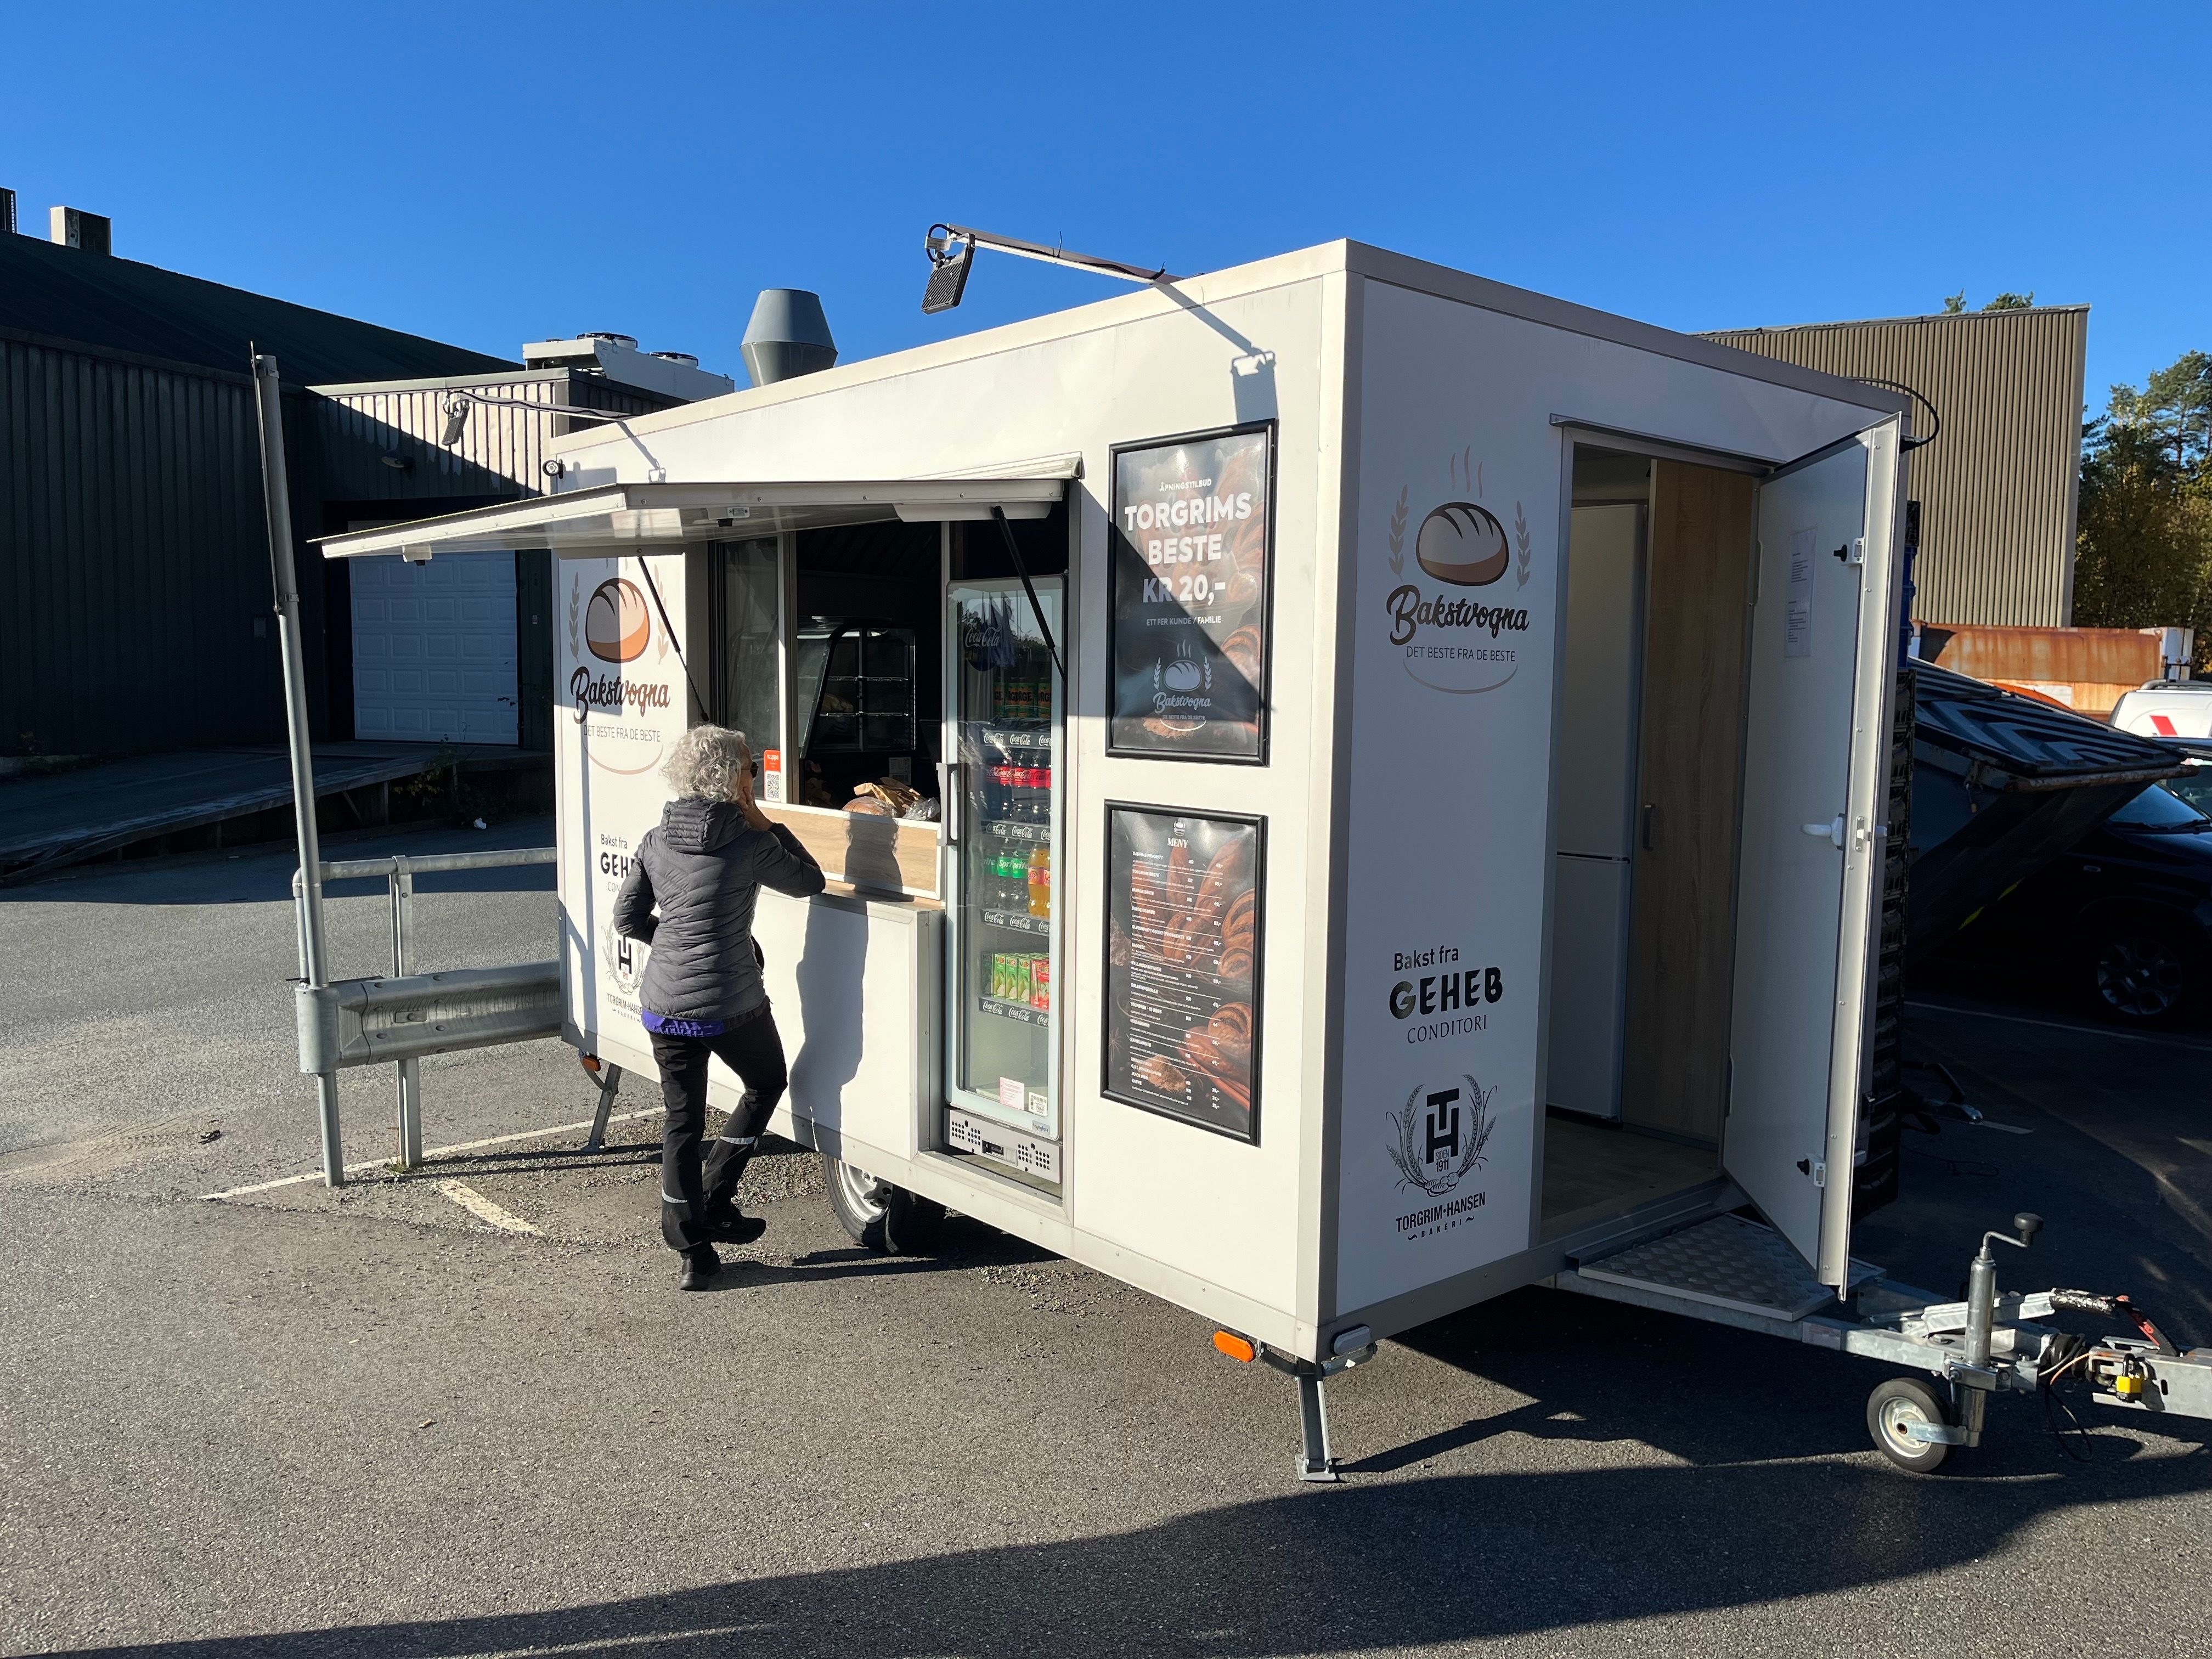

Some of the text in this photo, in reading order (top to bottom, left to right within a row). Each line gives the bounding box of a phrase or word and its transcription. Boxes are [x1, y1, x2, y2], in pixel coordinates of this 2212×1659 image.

[1160, 478, 1212, 492] ÅPNINGSTILBUD
[1124, 492, 1251, 531] TORGRIMS
[1148, 534, 1222, 565] BESTE
[1143, 574, 1226, 606] KR 20,-
[1169, 617, 1192, 625] KUNDE
[1197, 616, 1222, 624] FAMILIE
[1386, 584, 1530, 646] Bakstvogna
[1407, 646, 1515, 662] DET BESTE FRA DE BESTE
[570, 665, 671, 725] Bakstvogna
[1153, 691, 1211, 714] Bakstvogna
[584, 725, 661, 742] DET BESTE FRA DE BESTE
[601, 833, 628, 849] Bakst fra
[1167, 837, 1189, 848] MENY
[1394, 945, 1459, 971] Bakst fra
[1389, 967, 1503, 1019] GEHEB
[1407, 1015, 1487, 1043] CONDITORI
[1435, 1148, 1449, 1161] SIDEN
[1435, 1158, 1449, 1173] 1911
[1421, 1218, 1462, 1238] BAKERI
